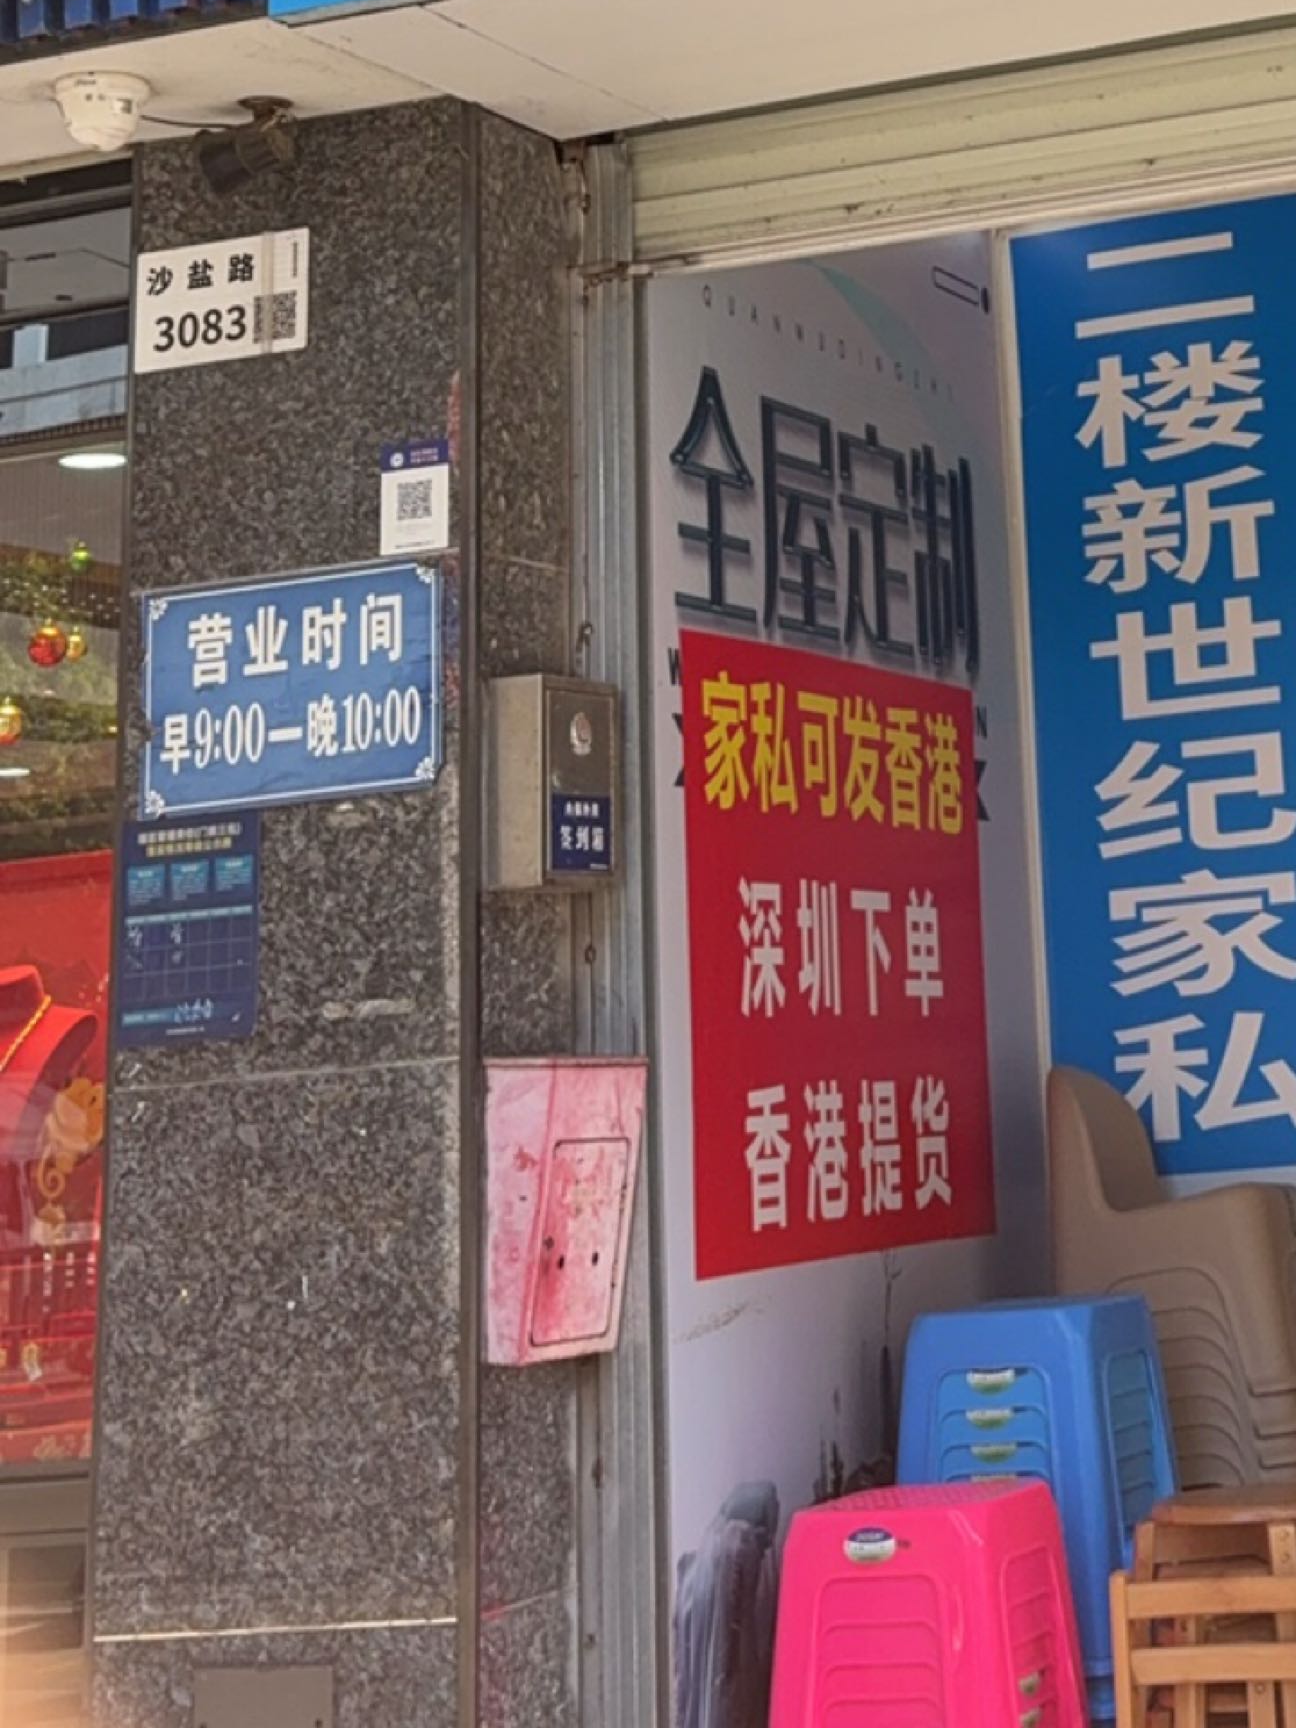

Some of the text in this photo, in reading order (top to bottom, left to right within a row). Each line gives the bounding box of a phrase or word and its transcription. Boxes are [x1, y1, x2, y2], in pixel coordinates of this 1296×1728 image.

[146, 253, 255, 296] 沙盐路
[152, 305, 246, 352] 3083
[669, 366, 980, 672] 全屋定制
[187, 592, 404, 690] 营业时间
[701, 671, 964, 835] 家私可发香港
[738, 877, 945, 1018] 深圳下单
[744, 1073, 953, 1232] 香港提货
